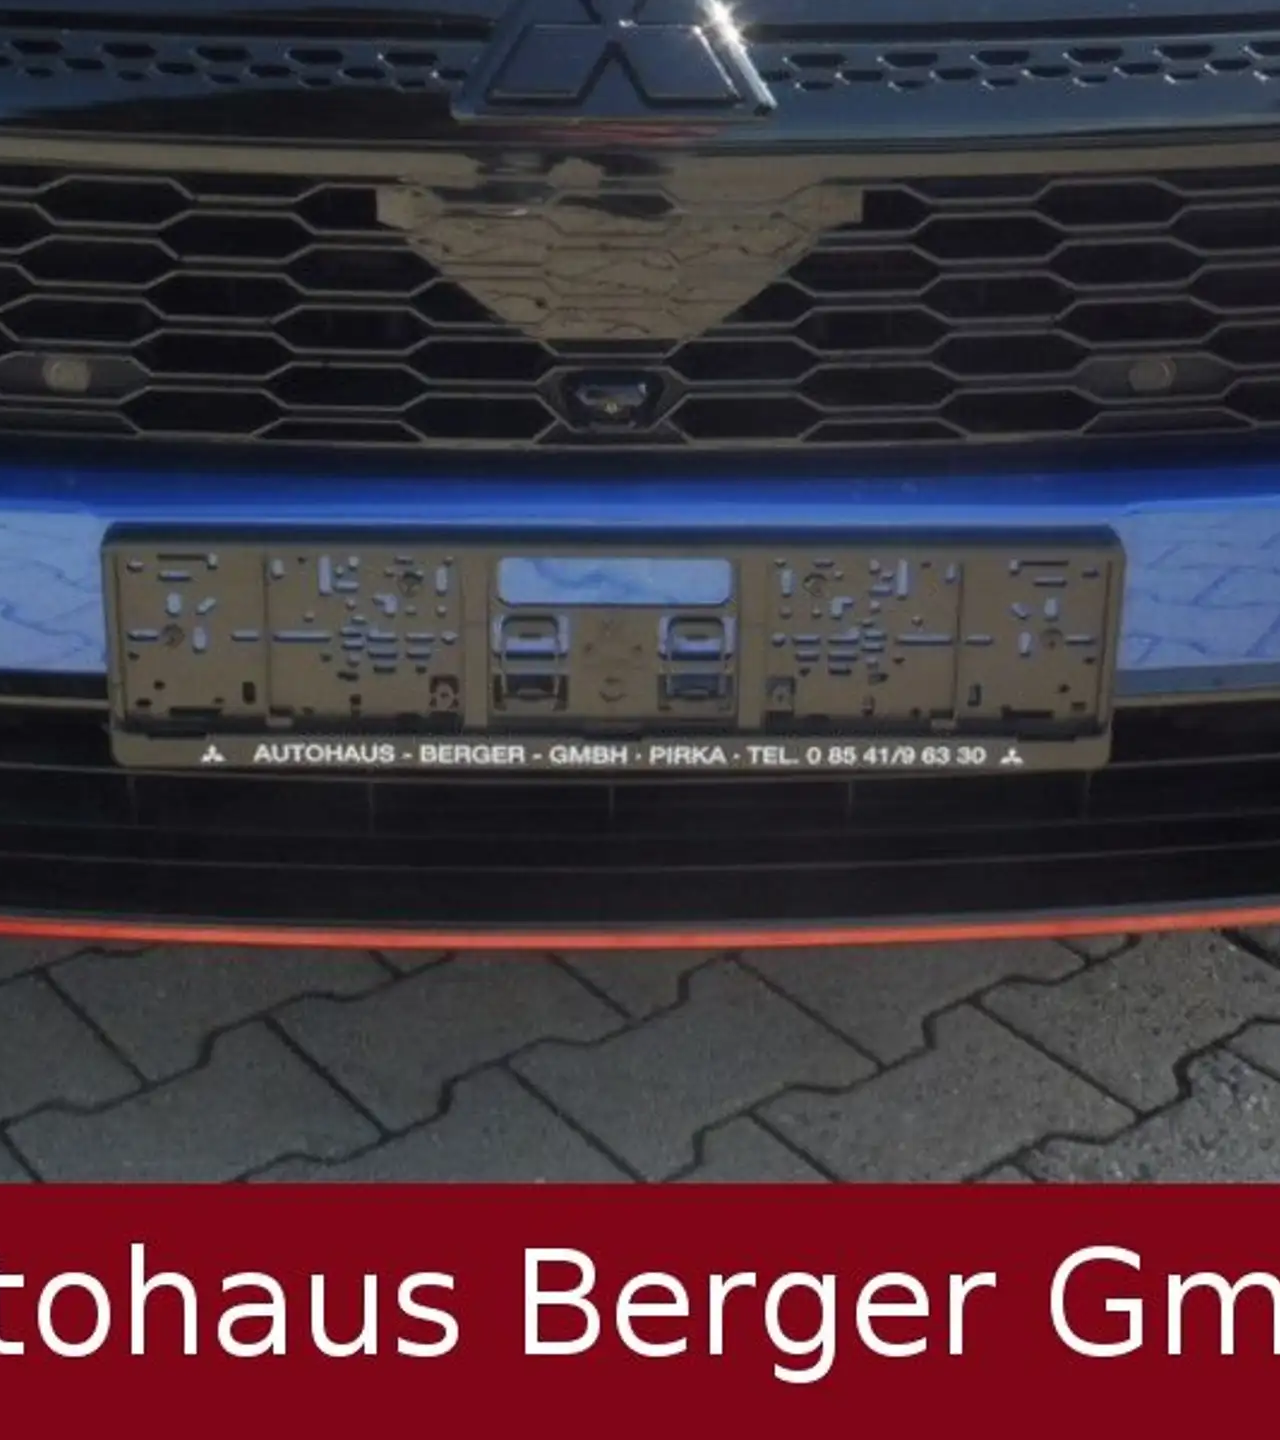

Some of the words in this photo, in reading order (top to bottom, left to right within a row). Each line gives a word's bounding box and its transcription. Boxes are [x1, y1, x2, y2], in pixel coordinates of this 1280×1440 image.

[253, 743, 396, 765] AUTOHAUS
[419, 743, 526, 765] BERGER
[548, 744, 629, 766] GMBH
[649, 744, 728, 766] PIRKA
[746, 744, 800, 766] TEL.
[805, 746, 823, 766] 0
[827, 745, 858, 767] 85
[863, 745, 917, 767] 41/9
[921, 745, 952, 766] 63
[956, 745, 988, 766] 30
